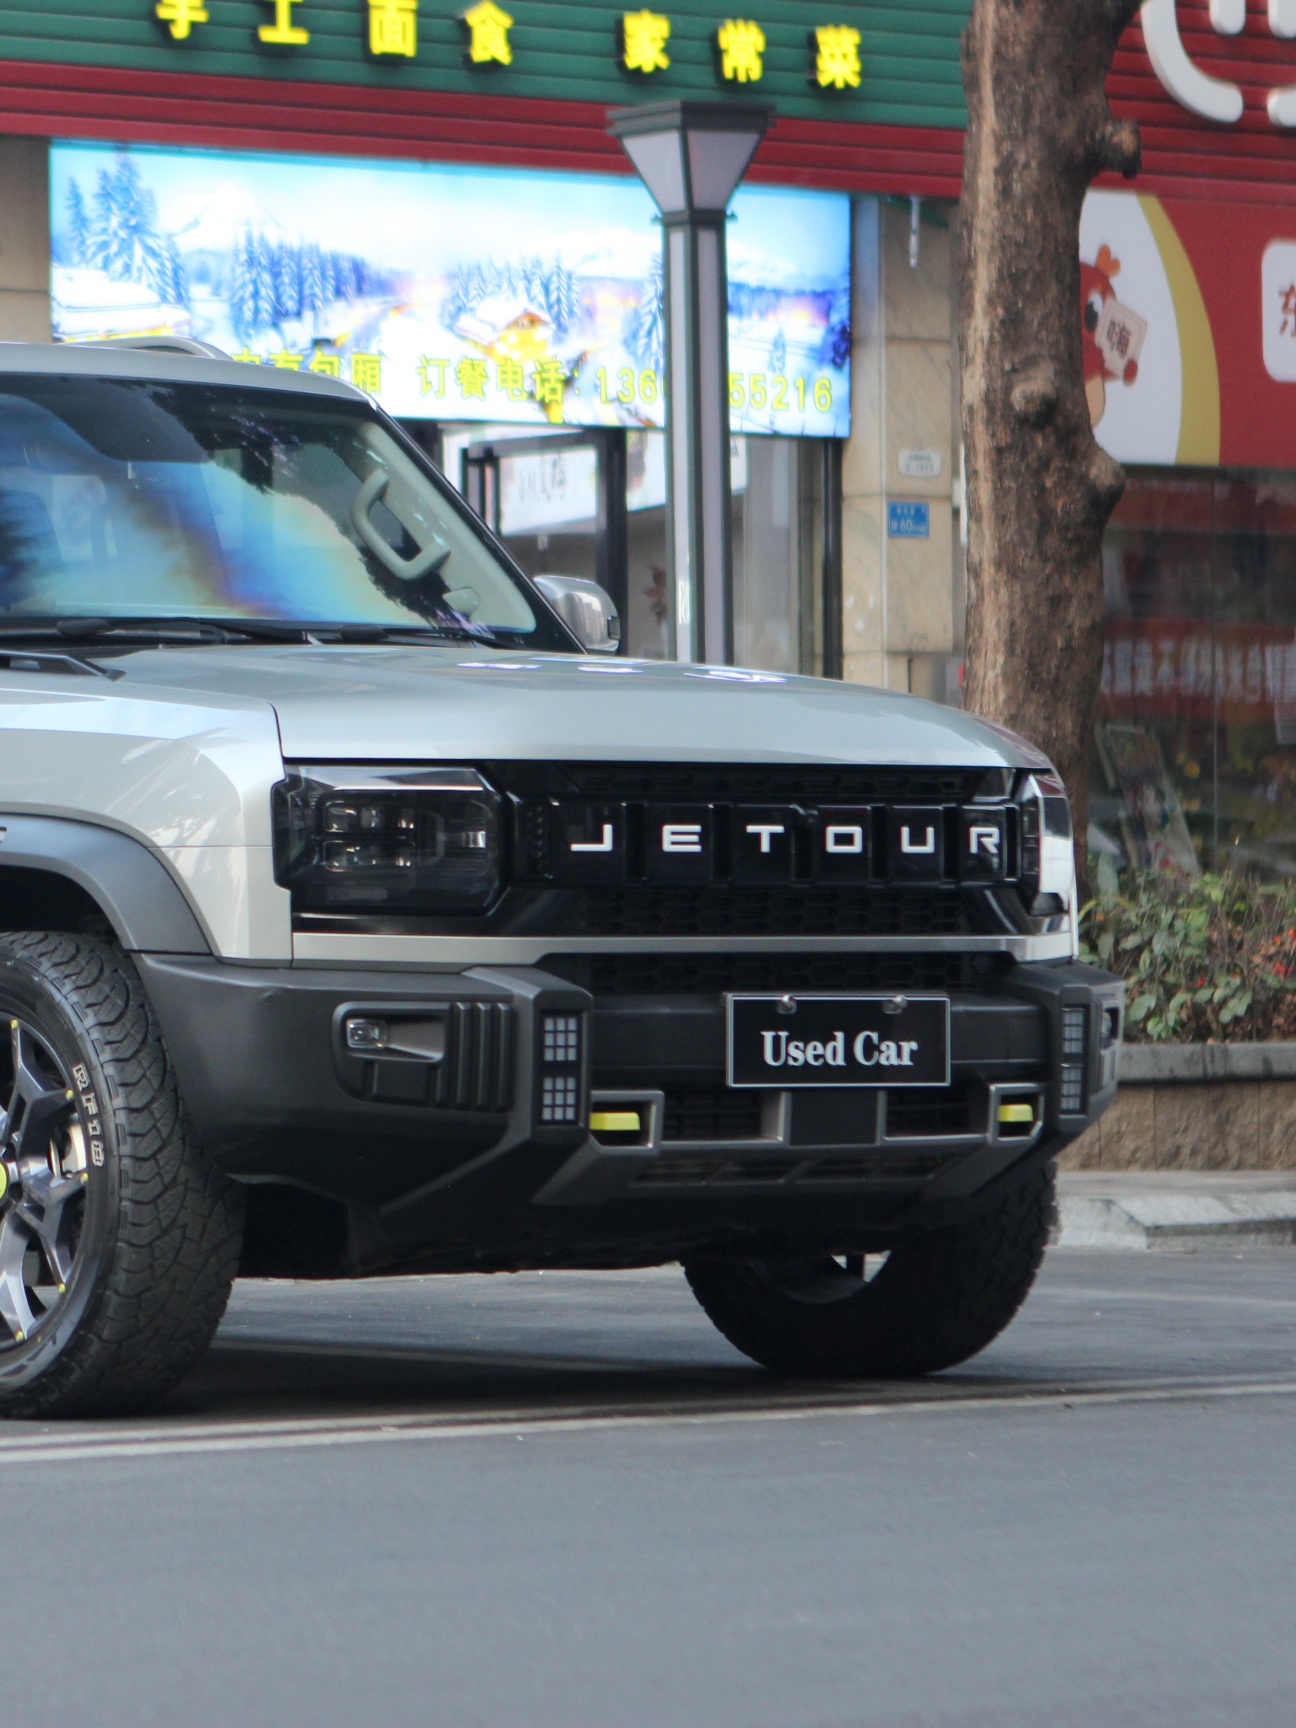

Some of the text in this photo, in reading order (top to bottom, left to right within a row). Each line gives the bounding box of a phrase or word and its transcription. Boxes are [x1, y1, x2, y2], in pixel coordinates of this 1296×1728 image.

[623, 9, 861, 88] 家常菜
[597, 367, 833, 412] 13655216
[570, 823, 1000, 854] JETOUR
[760, 1030, 918, 1066] Used Car
